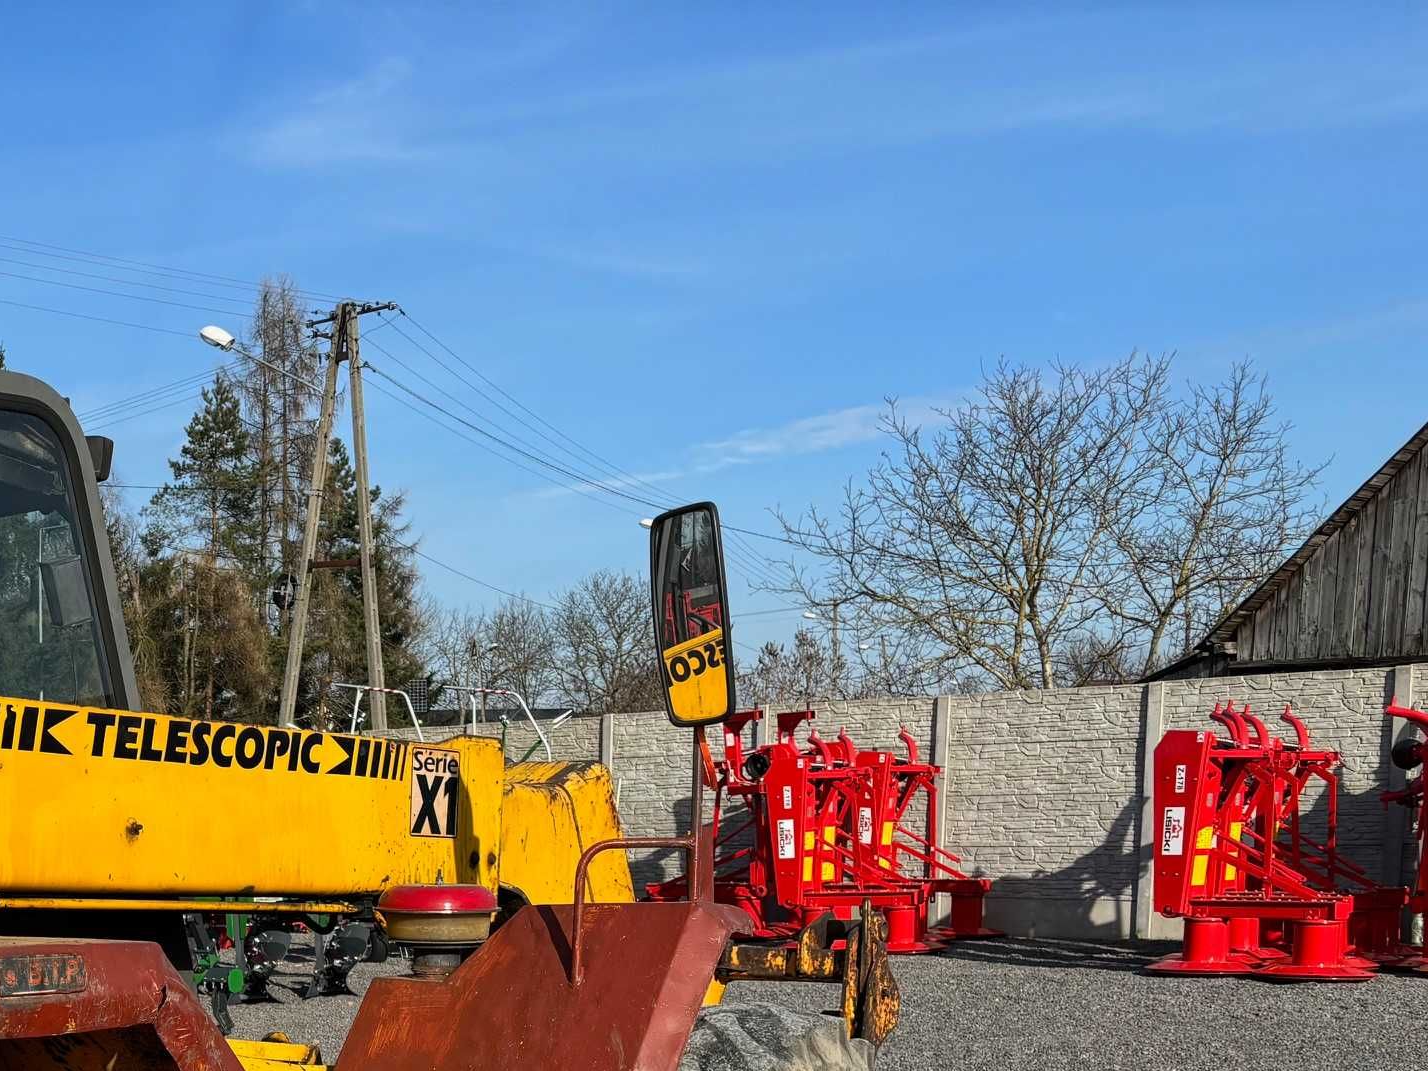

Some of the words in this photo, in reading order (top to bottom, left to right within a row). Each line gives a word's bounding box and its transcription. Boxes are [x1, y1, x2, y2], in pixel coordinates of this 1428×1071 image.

[87, 711, 324, 774] TELESCOPIC
[414, 751, 458, 774] Série
[412, 774, 458, 836] X1
[1164, 809, 1172, 852] LISICKI
